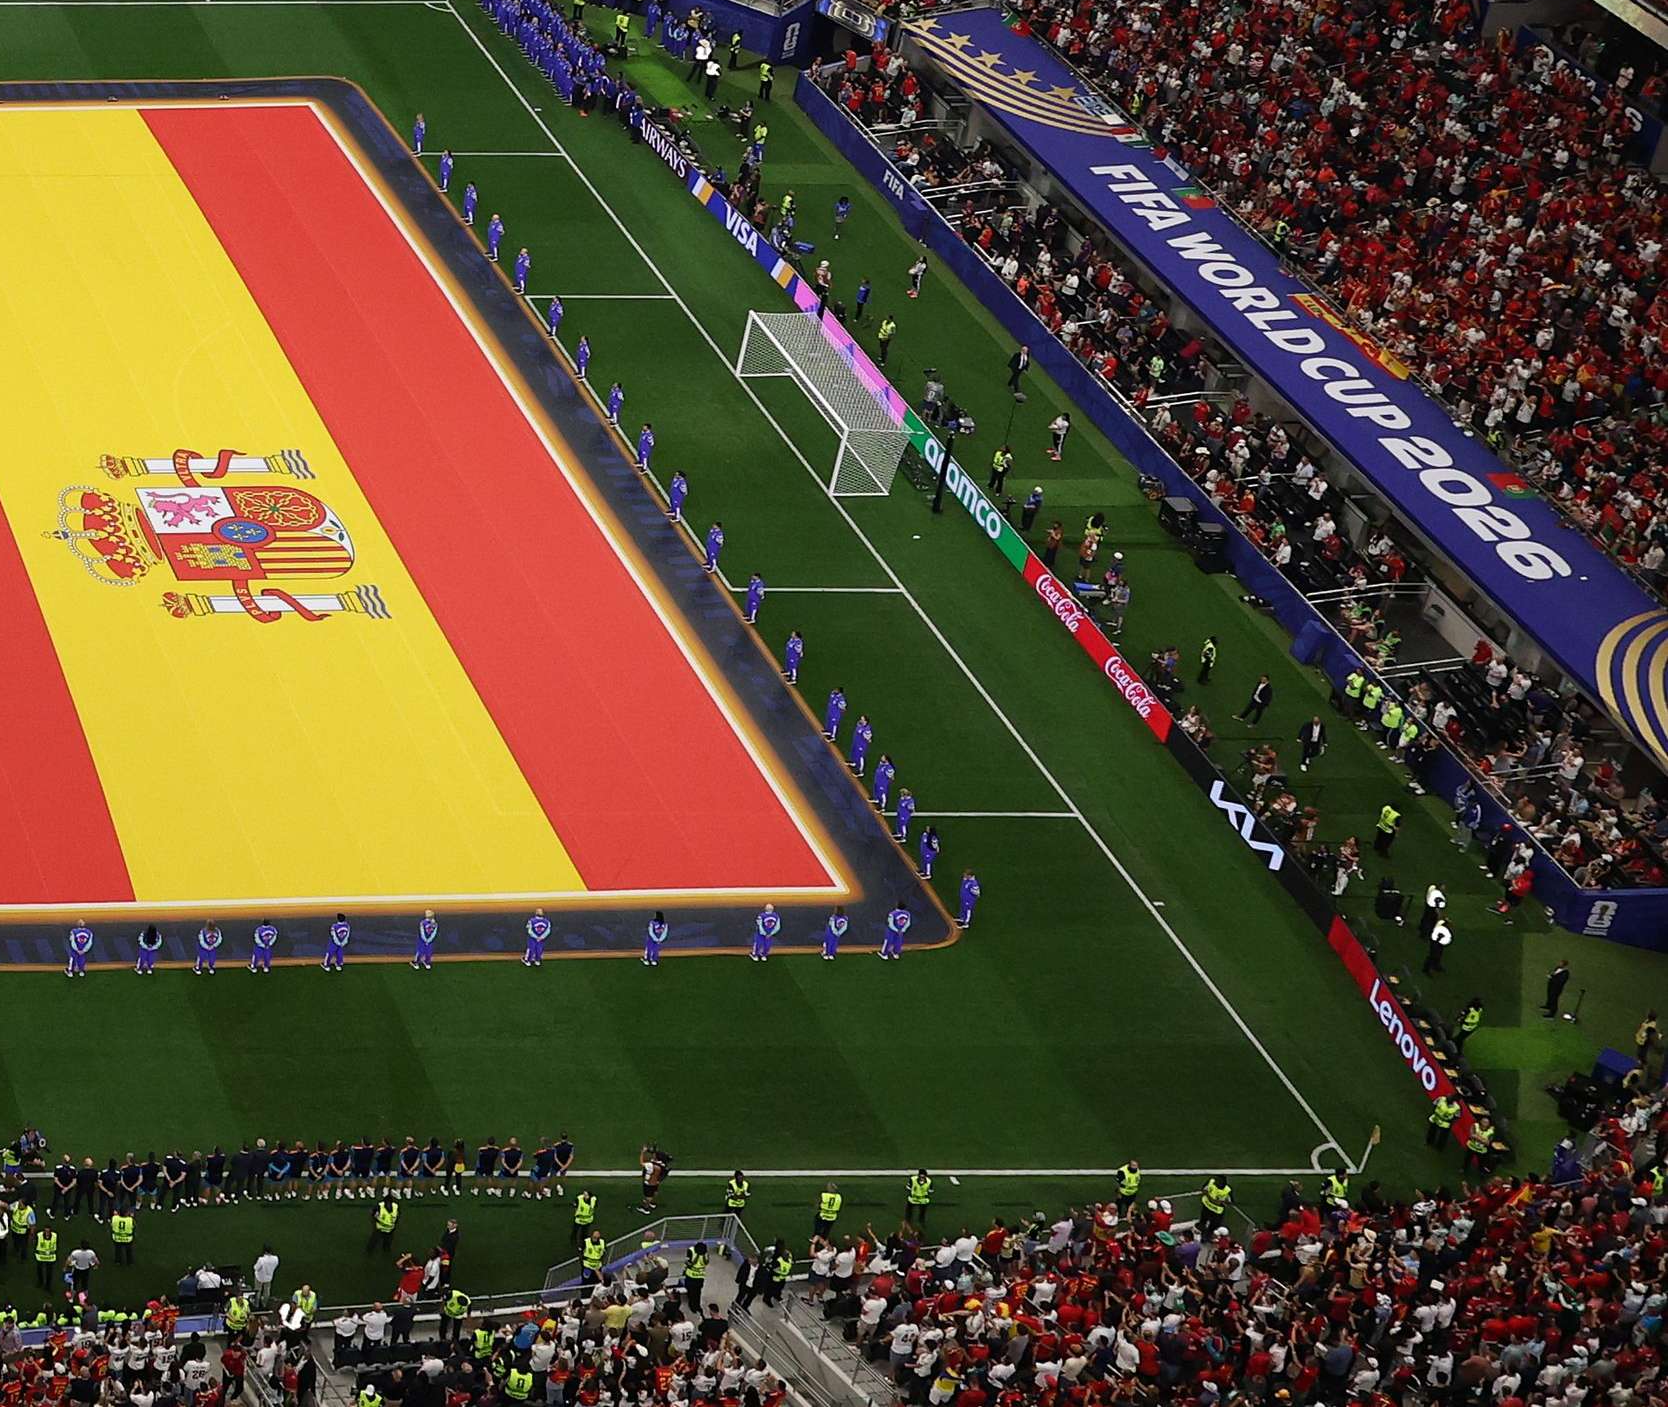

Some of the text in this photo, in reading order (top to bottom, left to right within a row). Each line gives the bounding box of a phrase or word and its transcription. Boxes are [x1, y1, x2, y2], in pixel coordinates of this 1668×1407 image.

[883, 169, 904, 200] FIFA
[724, 202, 758, 257] VISA
[1089, 164, 1193, 232] FIFA
[1163, 233, 1327, 355] WORLD
[1299, 357, 1412, 431] CUP
[1377, 436, 1572, 580] 2026
[1035, 574, 1085, 633] Coca-Cola
[1105, 655, 1155, 719] Coca-Cola
[1369, 978, 1437, 1091] Lenovo
